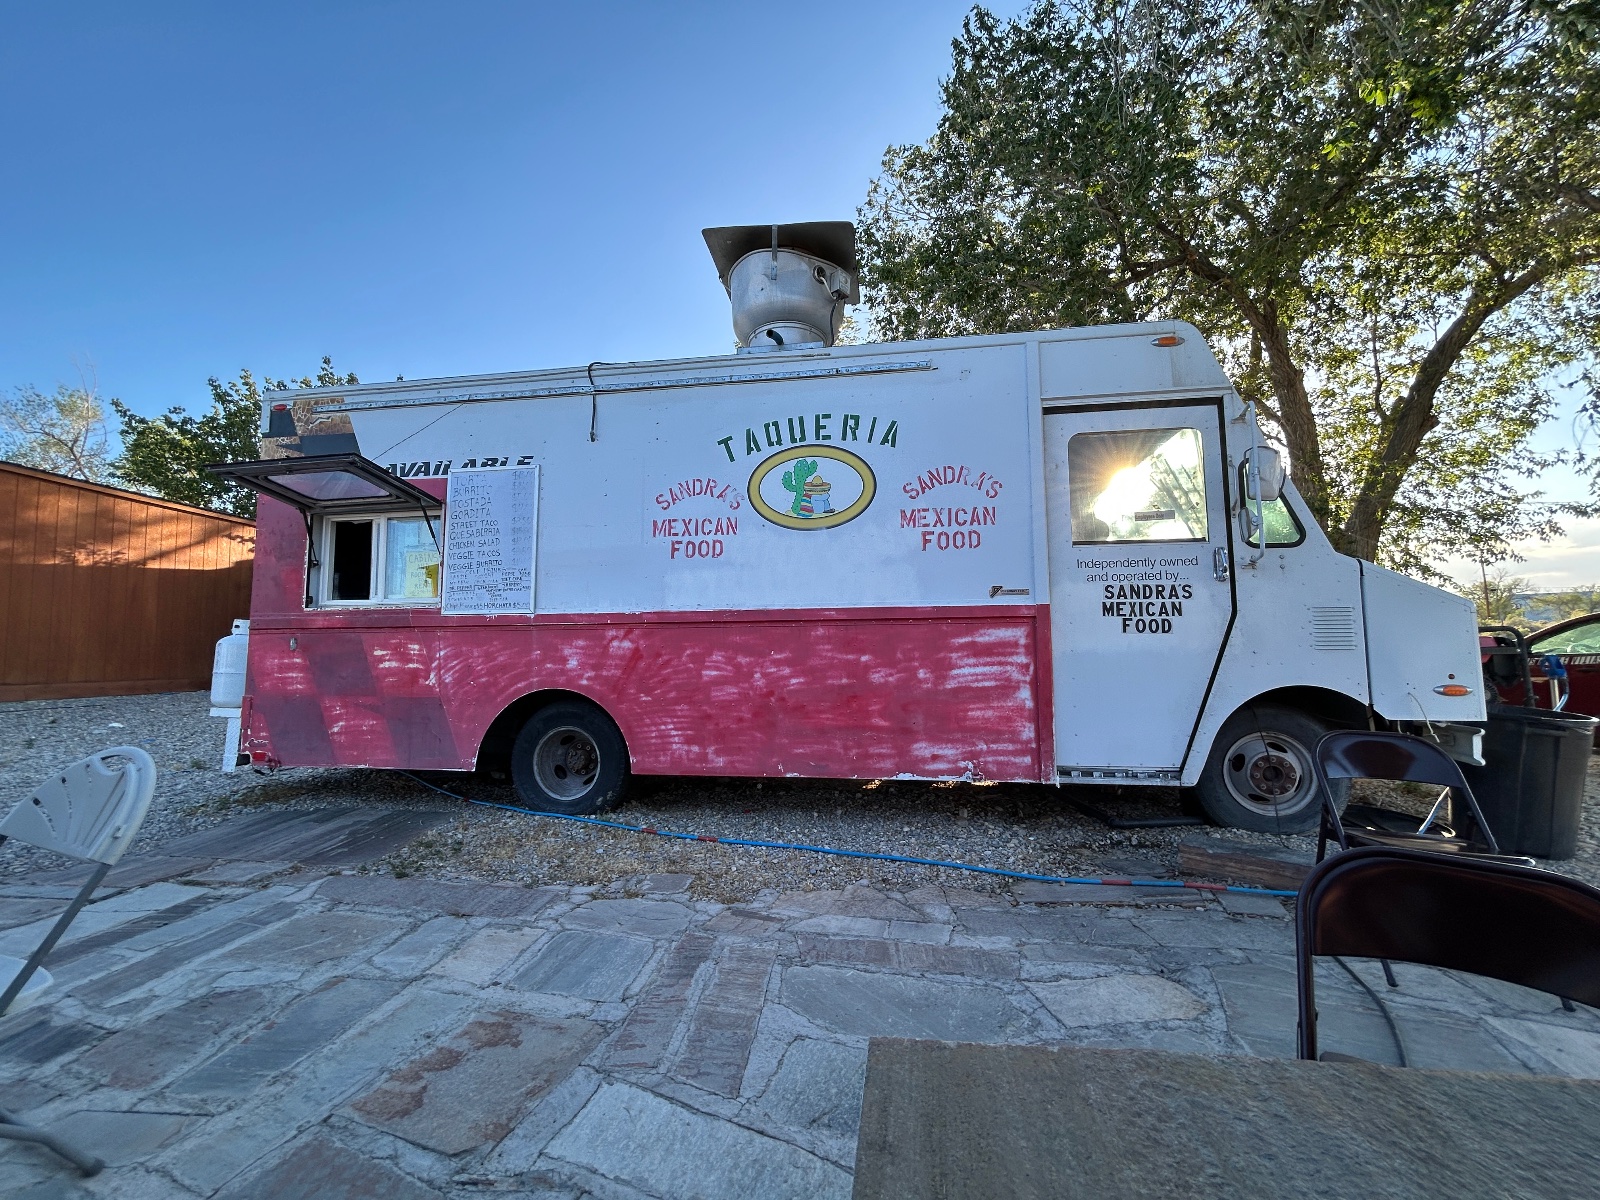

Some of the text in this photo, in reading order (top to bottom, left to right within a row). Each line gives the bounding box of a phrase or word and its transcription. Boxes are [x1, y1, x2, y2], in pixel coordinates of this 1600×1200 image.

[717, 413, 899, 463] TAQUERIA
[902, 465, 1003, 500] SANDRA'S
[655, 477, 746, 511] SANDRA'S
[451, 497, 492, 508] TOSTADA
[450, 508, 491, 520] GORDITA
[900, 506, 996, 529] MEXICAN
[450, 520, 478, 531] STREET
[480, 519, 499, 527] TACO
[652, 517, 738, 538] MEXICAN
[448, 541, 475, 551] CHICKEN
[478, 537, 501, 548] SALAD
[921, 529, 981, 552] FOOD
[448, 551, 475, 561] VEGGIE
[477, 549, 501, 558] TACOS
[670, 539, 724, 559] FOOD
[409, 552, 439, 563] CABINS
[448, 562, 474, 571] VEGGIE
[476, 559, 503, 569] BURRITO
[1077, 556, 1199, 570] Independently owned
[1086, 572, 1109, 582] and
[1111, 570, 1163, 584] operated
[1104, 583, 1193, 600] SANDRA'S
[1102, 601, 1183, 617] MEXICAN
[1122, 618, 1173, 634] FOOD
